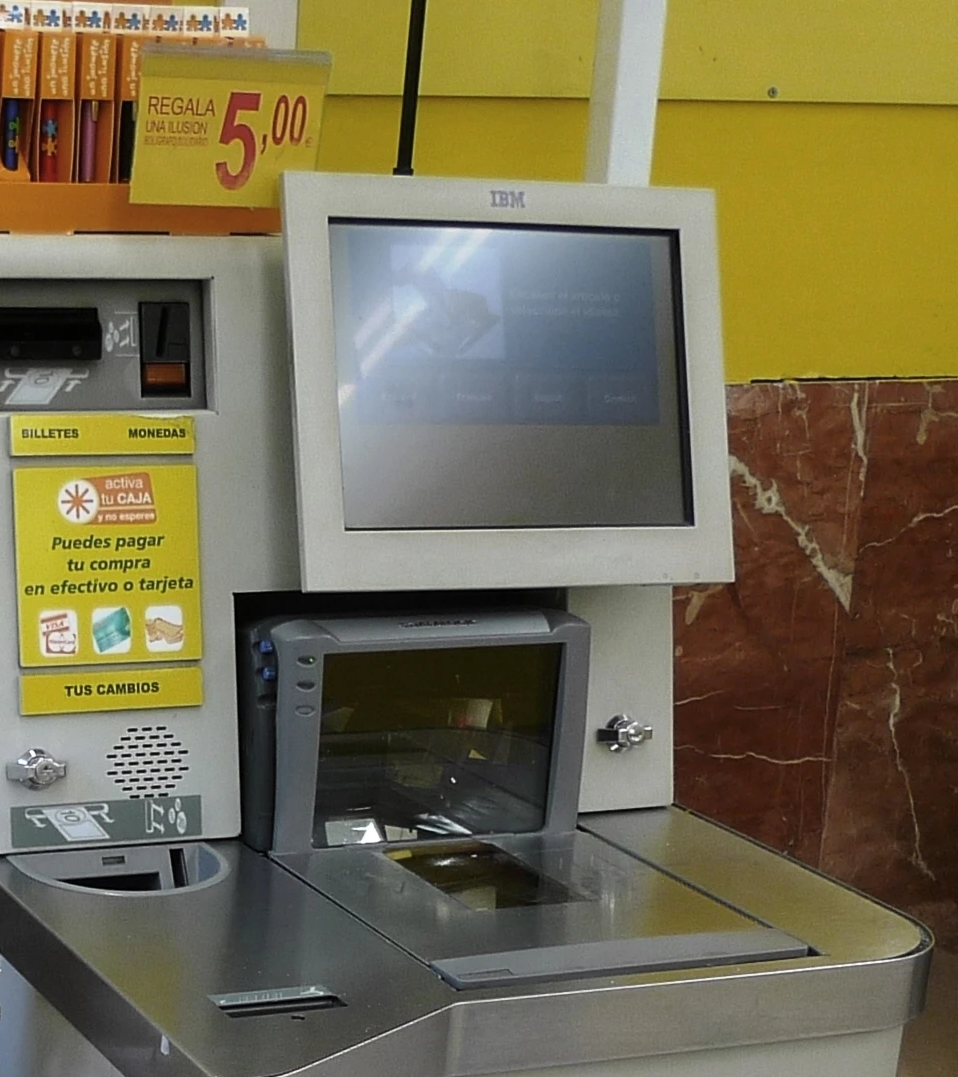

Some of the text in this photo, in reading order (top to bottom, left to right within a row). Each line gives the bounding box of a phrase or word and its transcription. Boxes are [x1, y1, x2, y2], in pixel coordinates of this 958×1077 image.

[147, 96, 216, 117] REGALA
[146, 121, 208, 135] UNA ILUSION
[490, 190, 526, 209] IBM
[21, 428, 80, 439] BILLETES
[128, 428, 186, 439] MONEDAS
[105, 477, 143, 489] activa
[101, 492, 152, 505] tu CAJA
[98, 514, 103, 523] y
[119, 513, 155, 522] esperes
[51, 534, 165, 551] Puedes pagar
[67, 558, 151, 574] tu compra
[24, 576, 194, 596] en efectivo o tarjeta
[64, 681, 160, 697] TUS CAMBIOS
